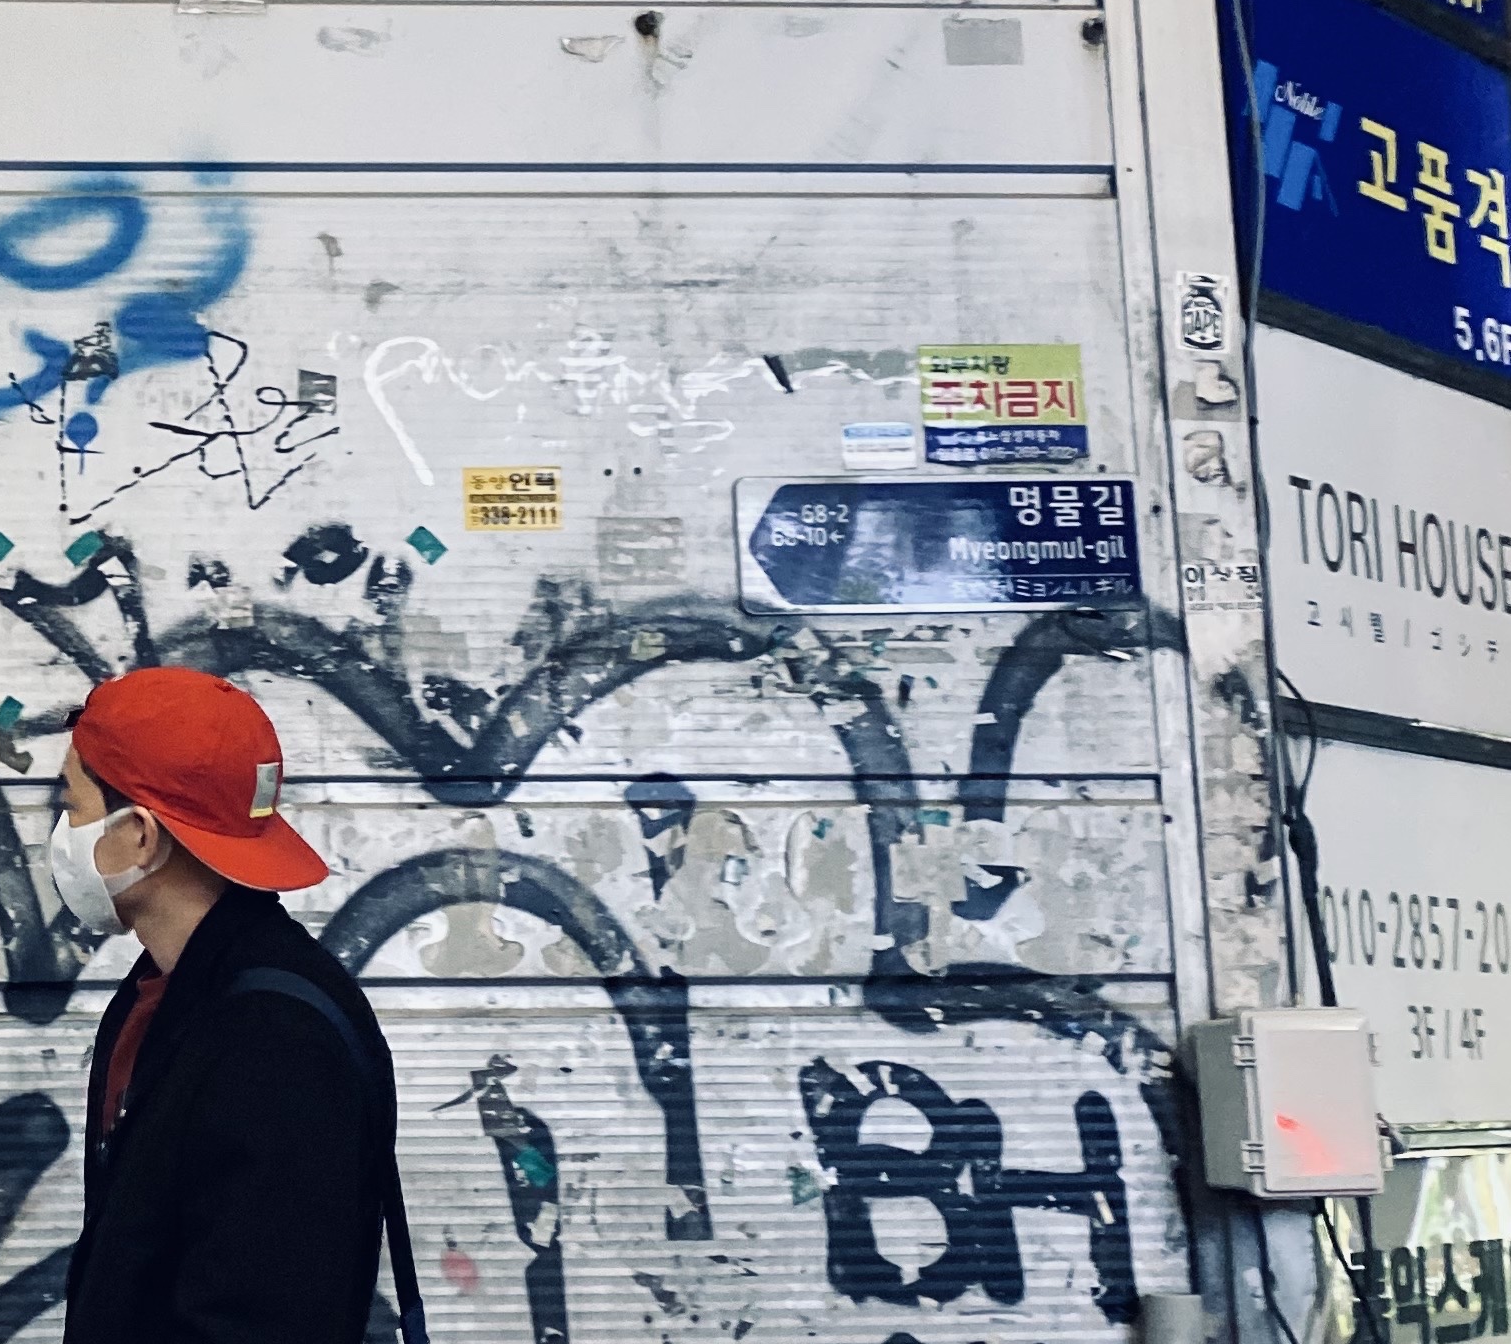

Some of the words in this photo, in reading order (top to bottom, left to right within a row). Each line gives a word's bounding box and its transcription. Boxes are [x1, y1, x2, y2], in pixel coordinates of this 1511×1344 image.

[931, 380, 1077, 419] 주차금지
[1009, 485, 1125, 527] 명물길
[949, 535, 1127, 565] Myeongmul-gil
[1288, 474, 1383, 582] TORI
[1395, 504, 1511, 614] HOUSE
